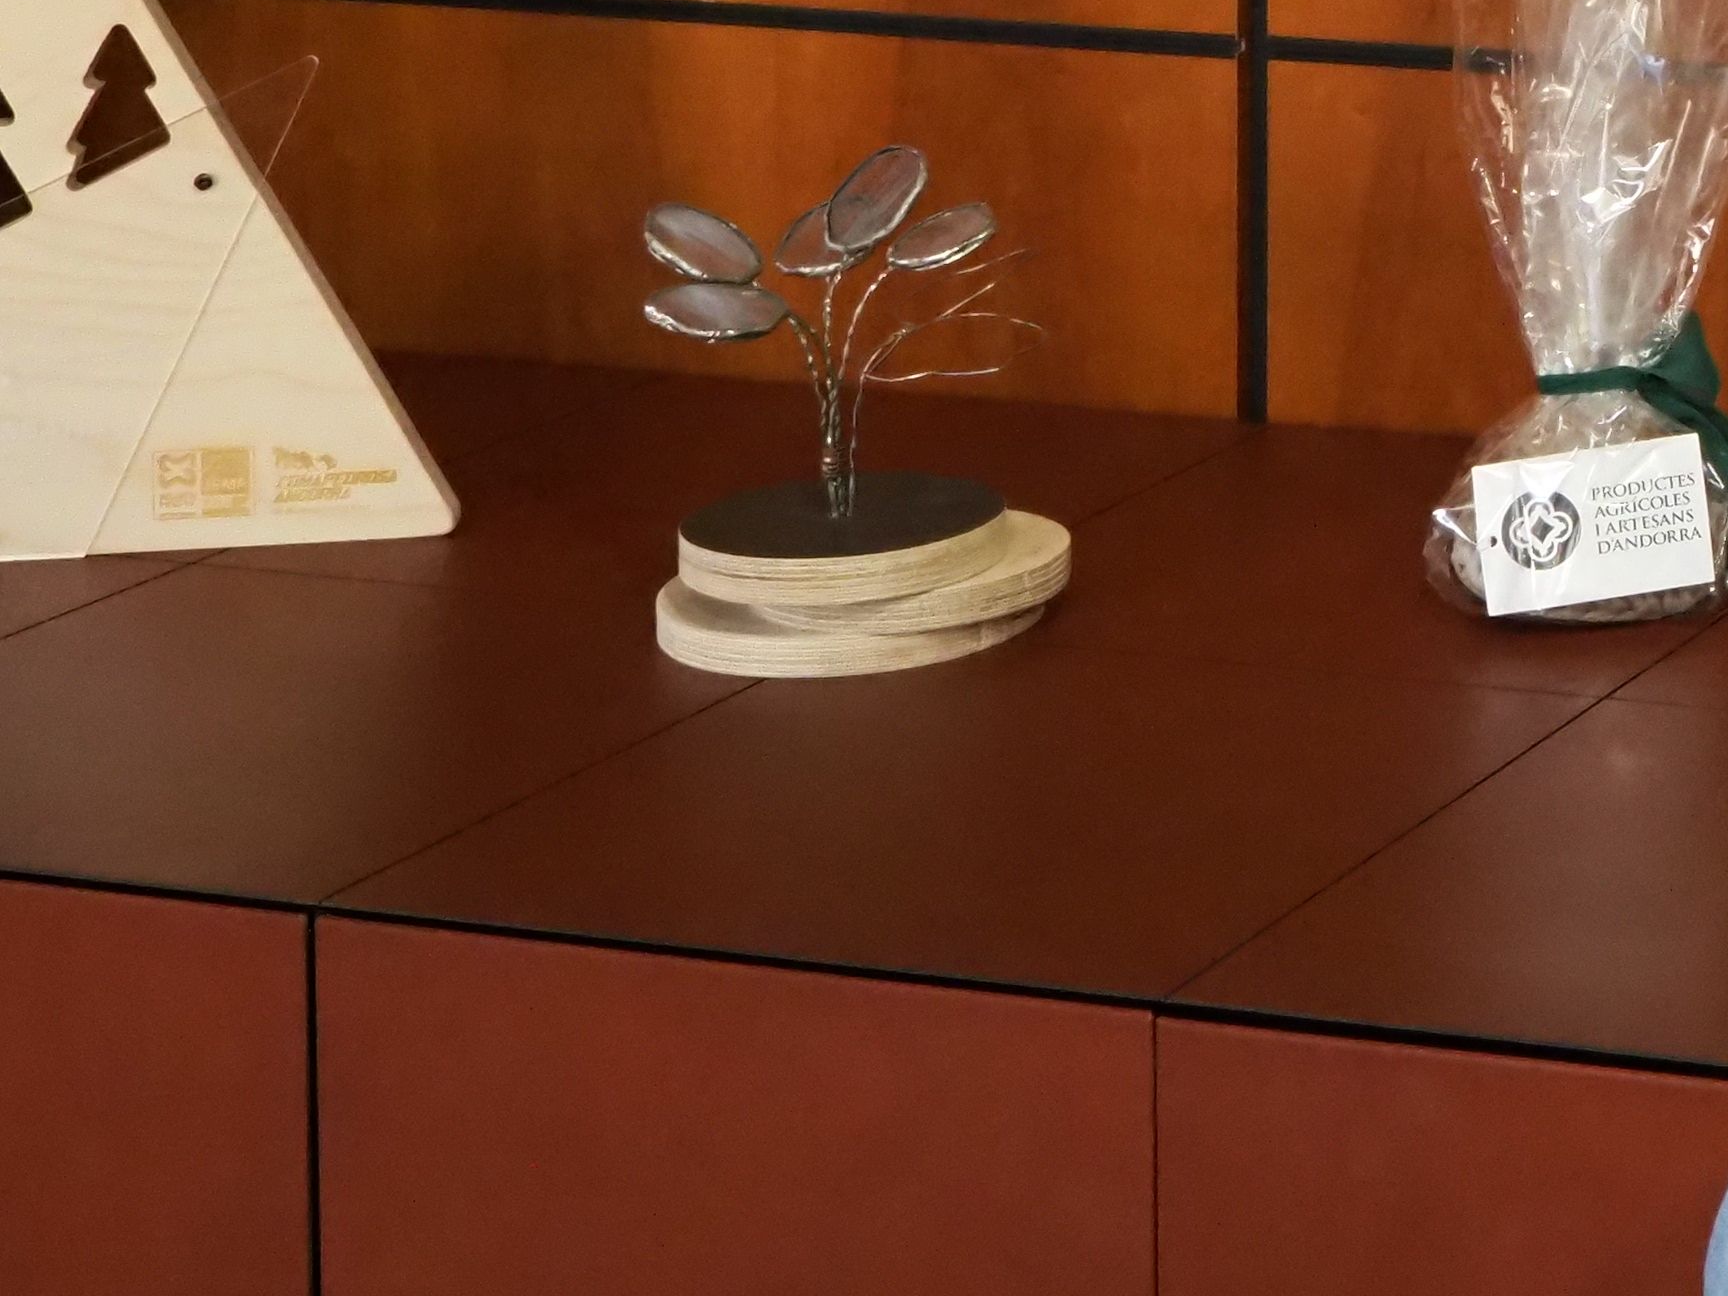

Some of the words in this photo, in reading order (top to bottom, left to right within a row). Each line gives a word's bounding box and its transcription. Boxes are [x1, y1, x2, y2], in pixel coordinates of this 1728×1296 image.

[1592, 472, 1695, 501] PRODUCTES
[1595, 523, 1600, 536] I
[1606, 509, 1694, 535] ARTESANS
[1598, 526, 1702, 554] D'ANDORRA
